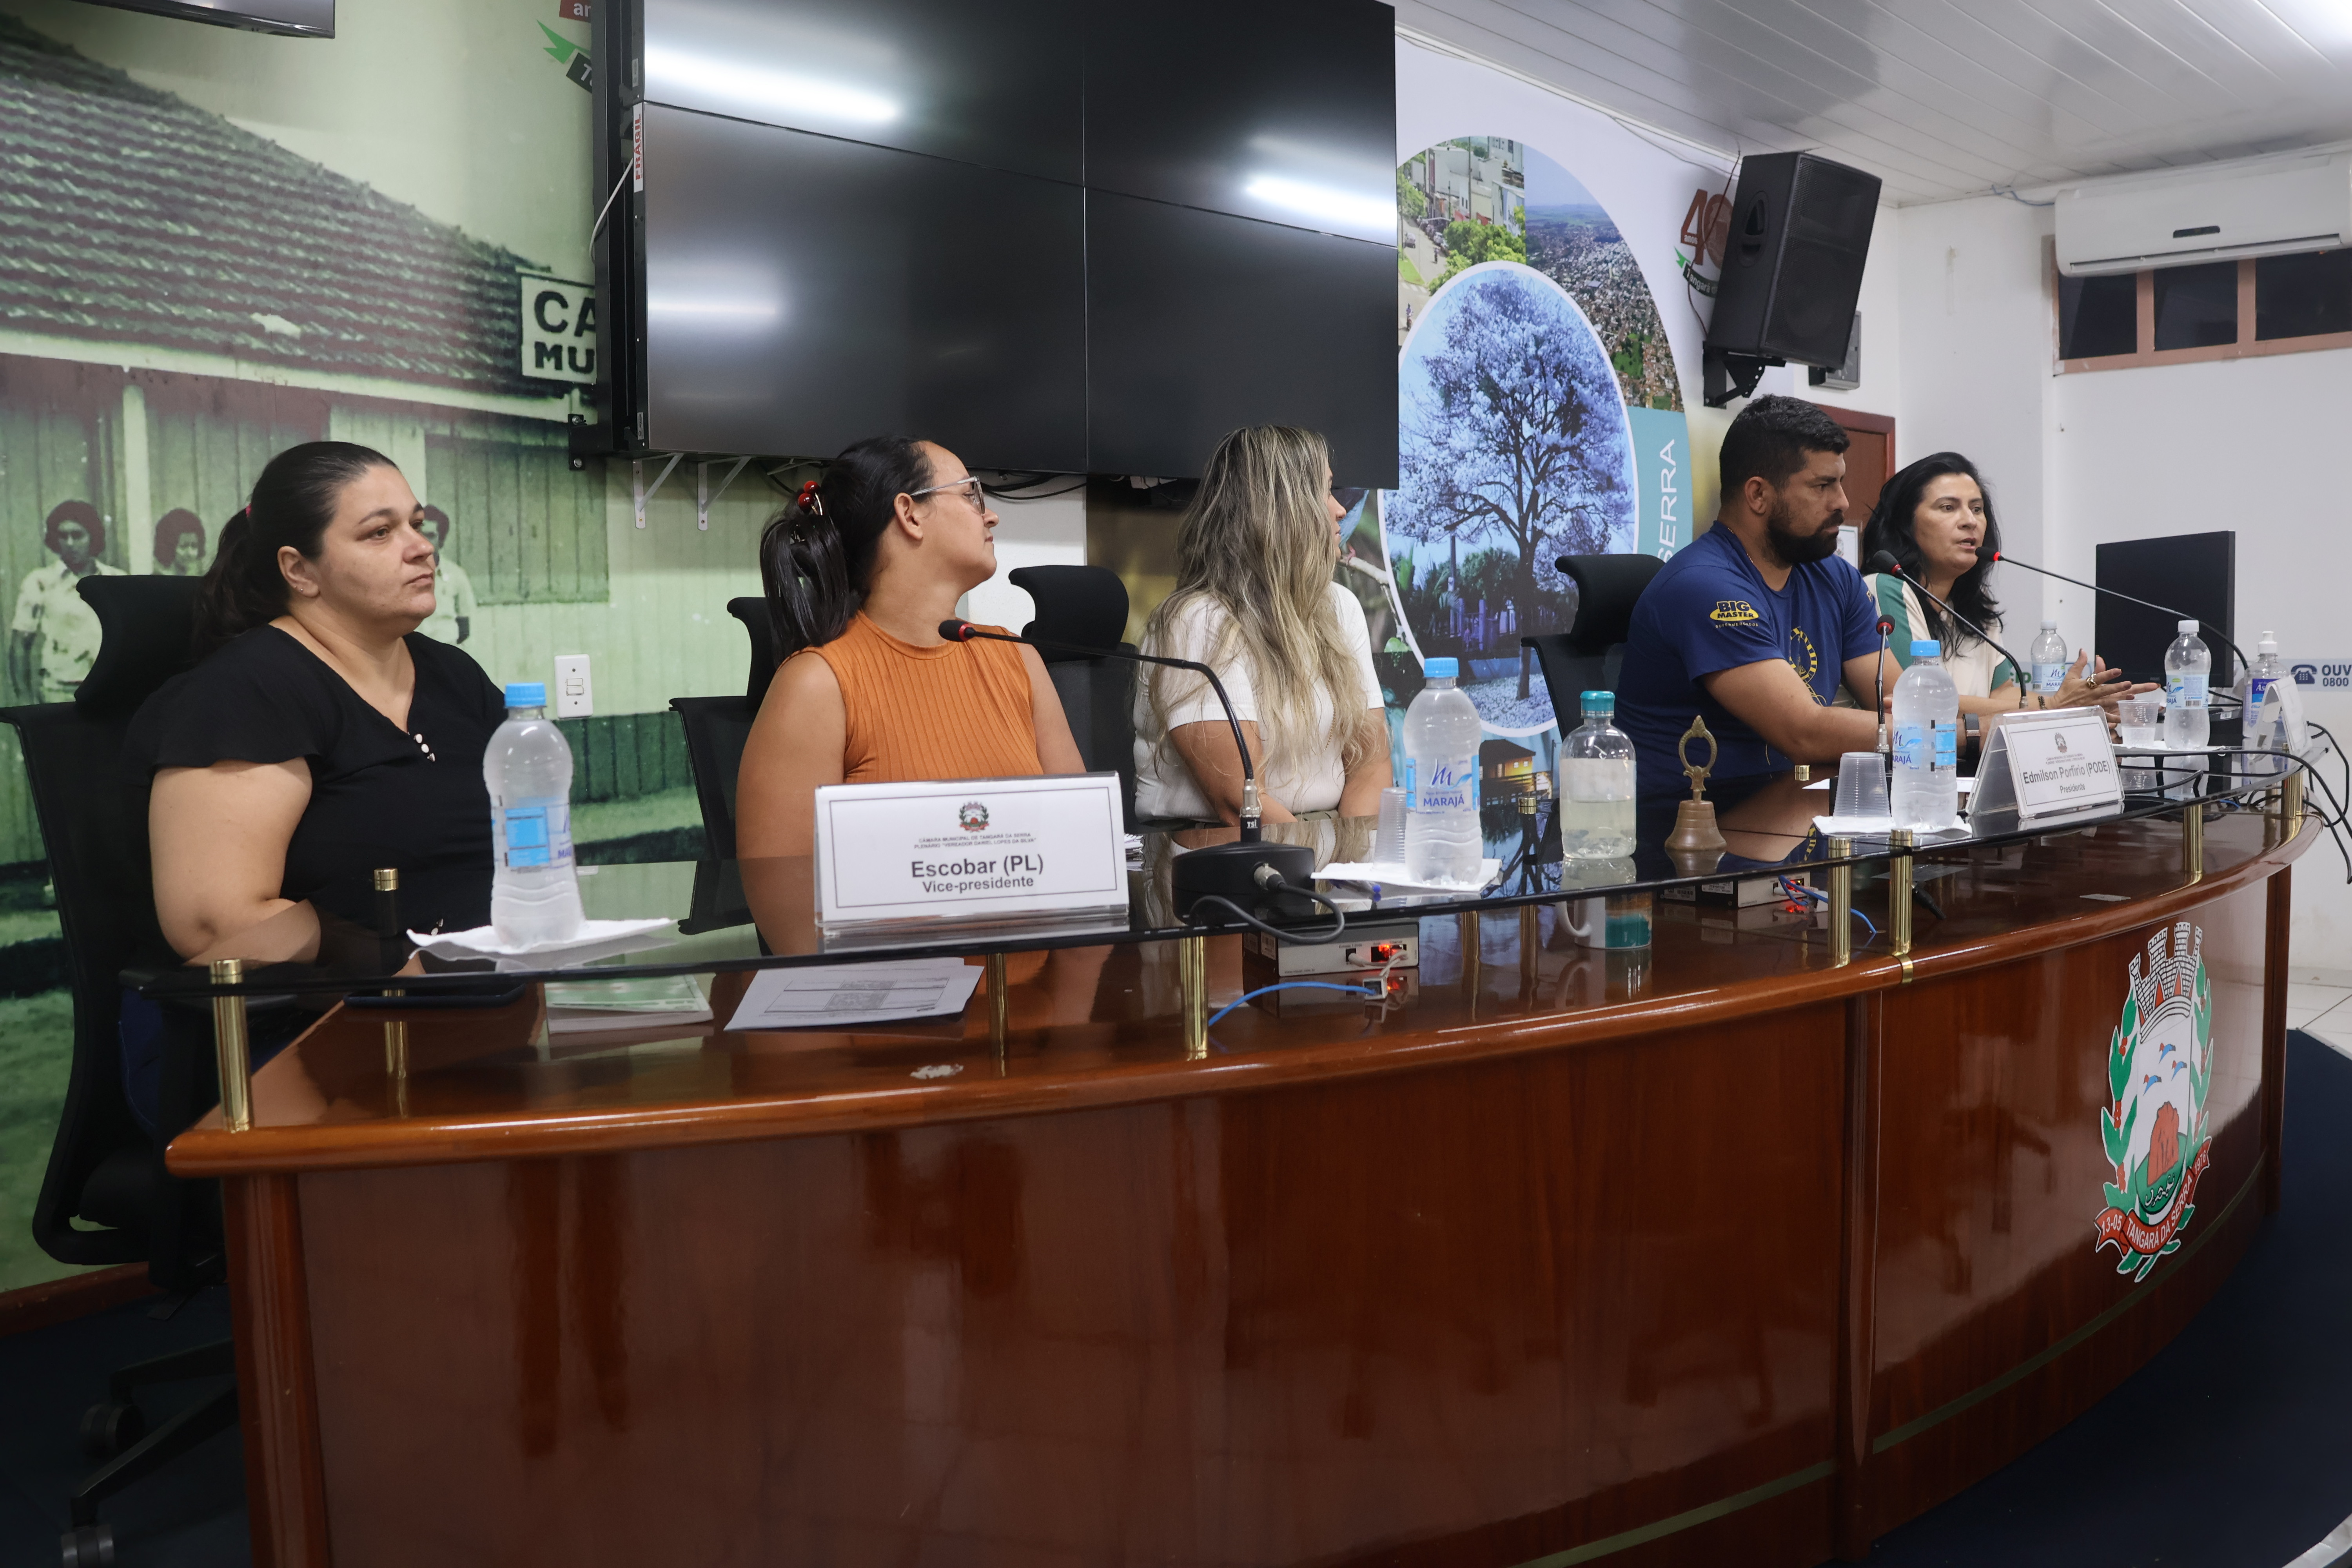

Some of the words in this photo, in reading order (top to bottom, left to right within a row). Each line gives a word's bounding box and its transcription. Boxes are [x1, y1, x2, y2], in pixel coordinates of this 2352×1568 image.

[534, 341, 595, 374] MU
[1718, 601, 1750, 612] BIG
[2322, 664, 2352, 676] OUV
[2323, 677, 2349, 686] 0800
[2023, 769, 2058, 784] Edmilson
[2086, 760, 2111, 777] (PODE)
[2060, 783, 2085, 793] Presidente
[1423, 793, 1465, 808] MARAJÁ
[912, 858, 997, 878] Escobar
[1004, 854, 1043, 877] (PL)
[922, 876, 1034, 893] Vice-presidente
[2102, 1214, 2123, 1236] 13-05
[2126, 1217, 2159, 1250] TANGARÁ
[2160, 1220, 2171, 1242] DA
[2171, 1174, 2192, 1227] SERRA
[2194, 1150, 2206, 1174] 1976
